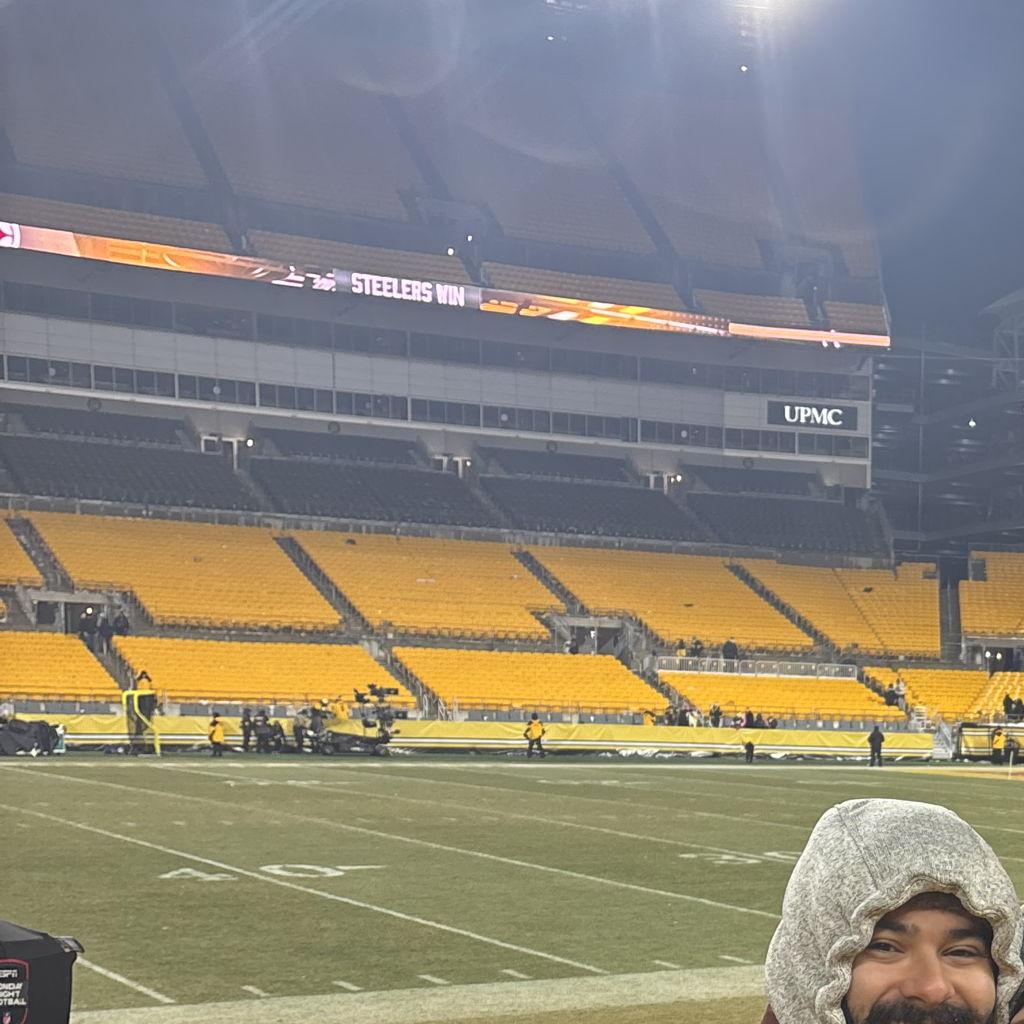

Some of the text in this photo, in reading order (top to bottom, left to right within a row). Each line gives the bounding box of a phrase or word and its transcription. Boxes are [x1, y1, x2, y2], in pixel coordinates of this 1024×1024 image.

[351, 272, 465, 307] STEELERS WIN
[784, 405, 843, 426] UPMC
